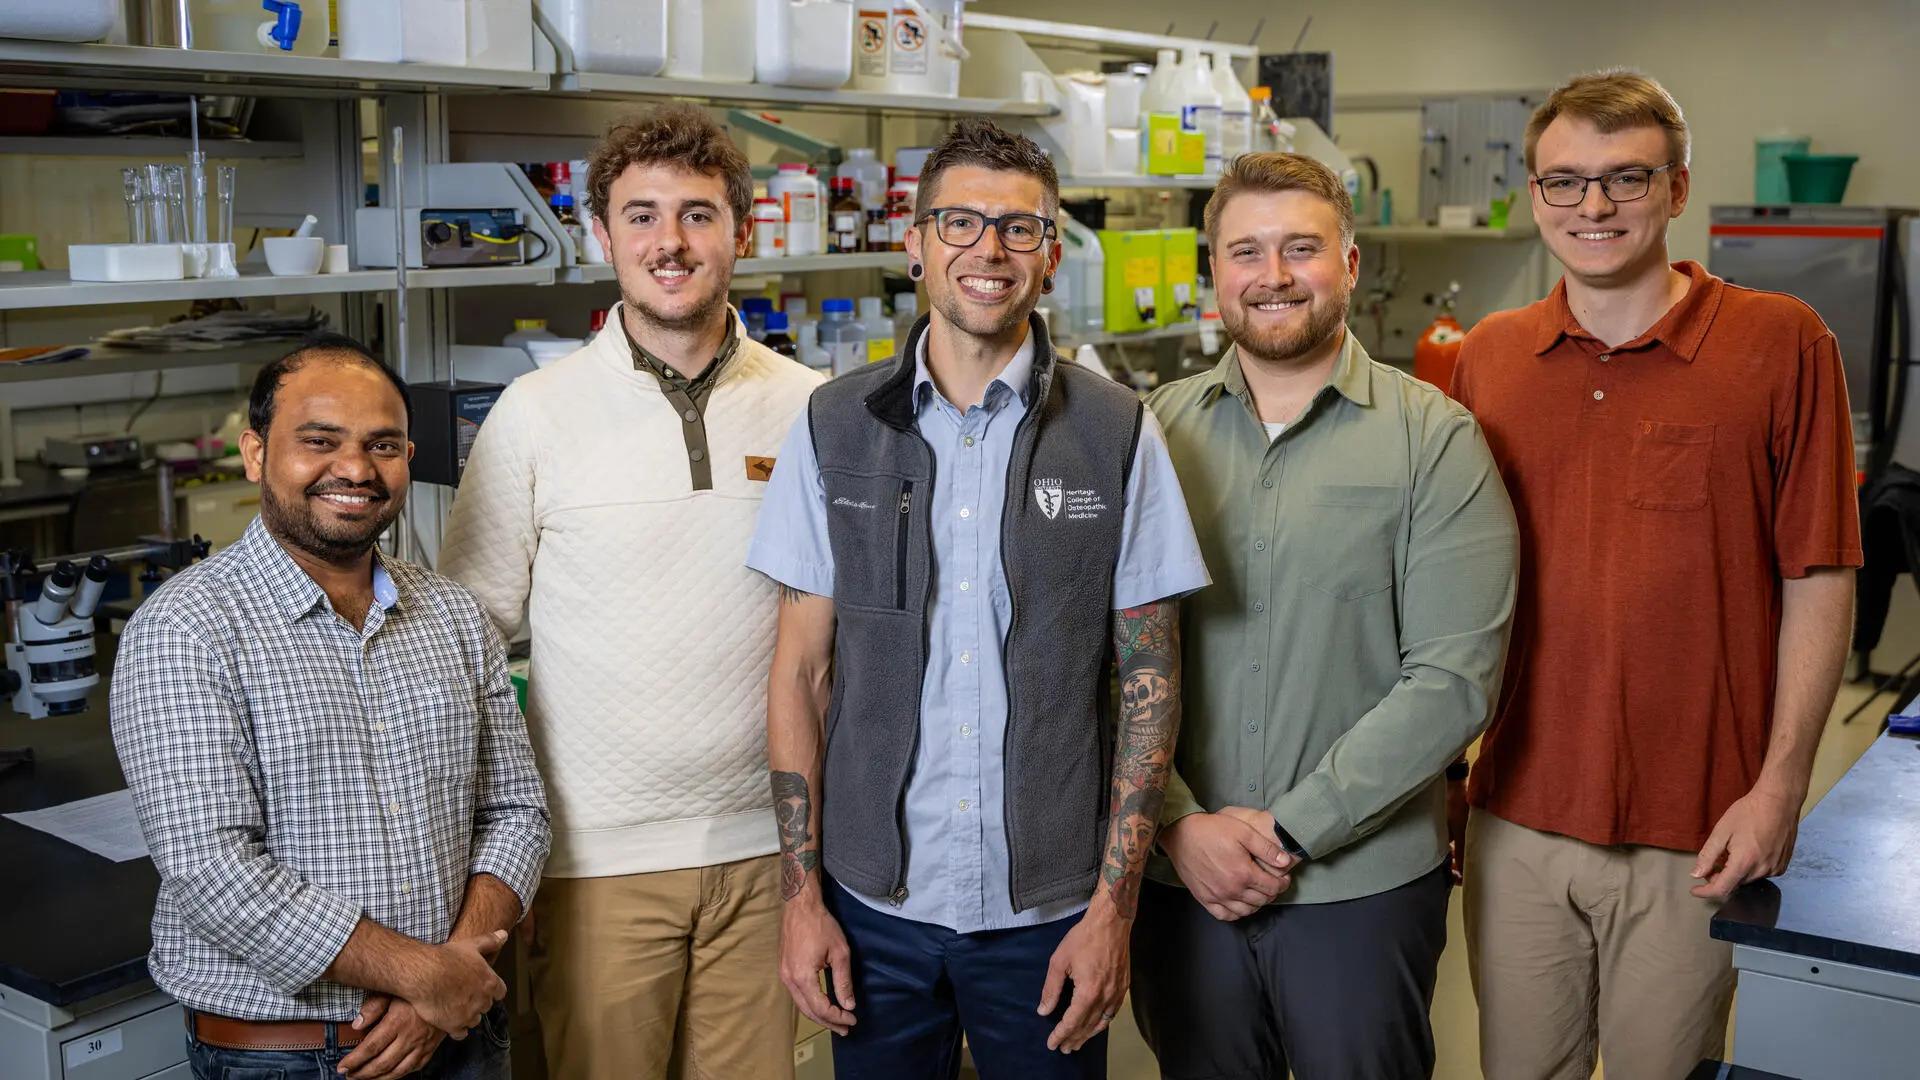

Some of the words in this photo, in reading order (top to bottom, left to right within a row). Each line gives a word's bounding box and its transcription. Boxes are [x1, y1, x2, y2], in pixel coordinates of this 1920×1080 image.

[1034, 478, 1062, 486] OHIO
[1067, 503, 1107, 511] Osteopathic
[88, 1039, 102, 1054] 30
